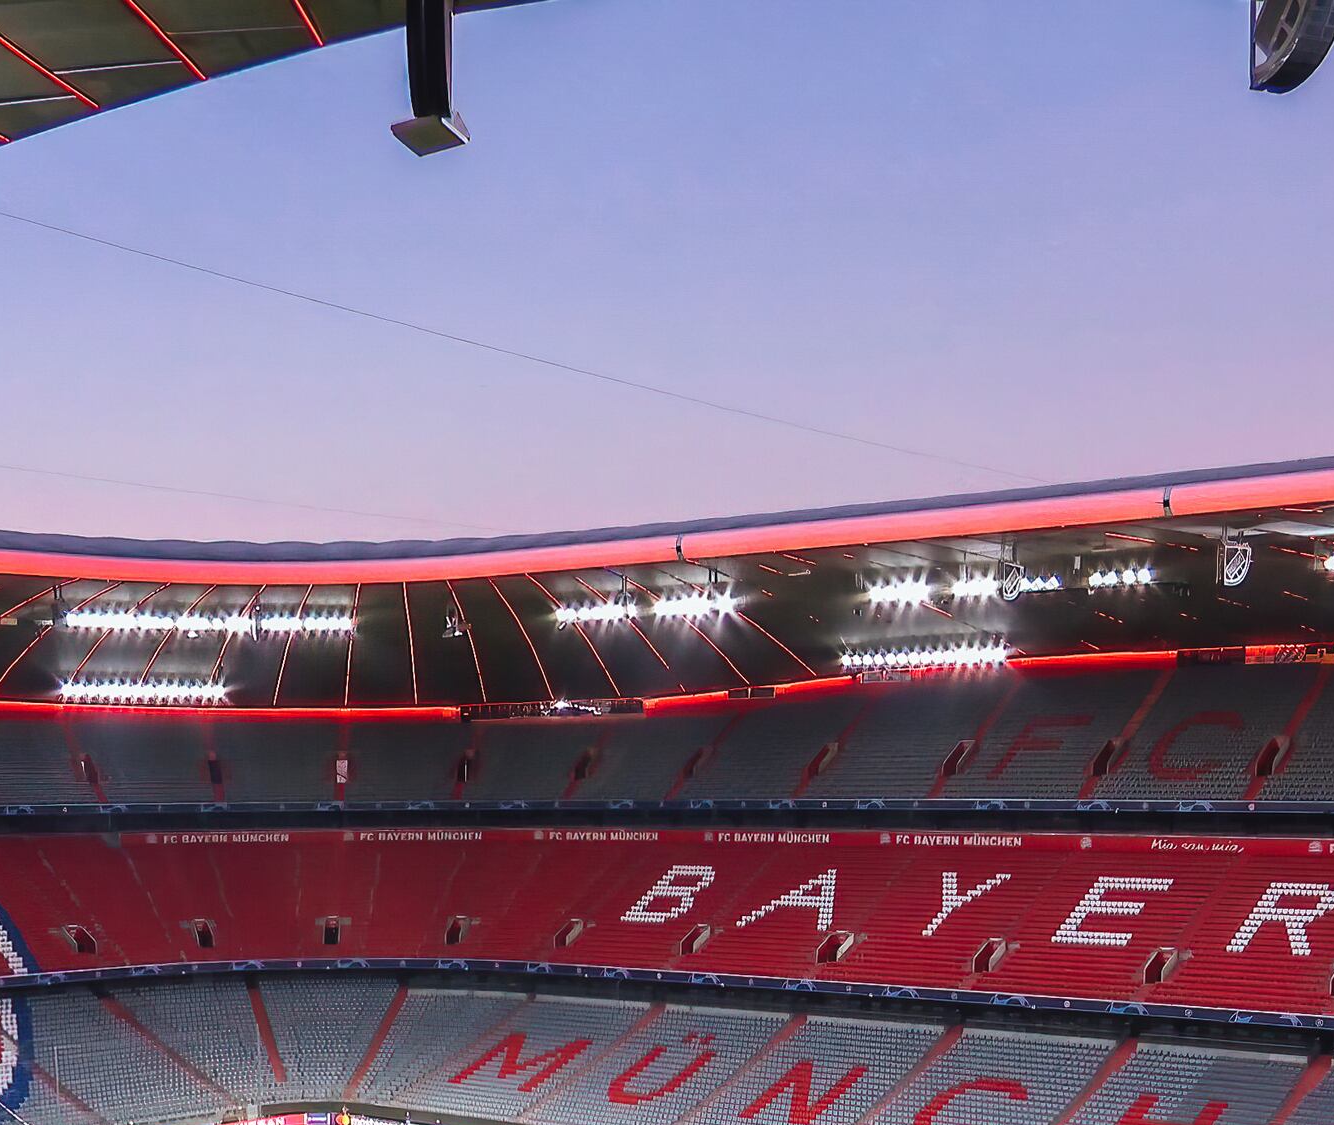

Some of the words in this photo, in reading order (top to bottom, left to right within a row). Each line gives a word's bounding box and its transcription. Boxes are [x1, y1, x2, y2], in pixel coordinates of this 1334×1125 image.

[986, 714, 1245, 781] FC
[163, 835, 178, 844] FC
[181, 834, 228, 844] BAYERN
[359, 832, 375, 841] FC
[378, 832, 423, 841] BAYERN
[549, 831, 563, 841] FC
[565, 831, 607, 841] BAYERN
[718, 832, 731, 842] FC
[734, 832, 774, 843] BAYERN
[896, 834, 910, 845] FC
[914, 834, 959, 846] BAYERN
[963, 833, 1022, 847] MÜNCHEN
